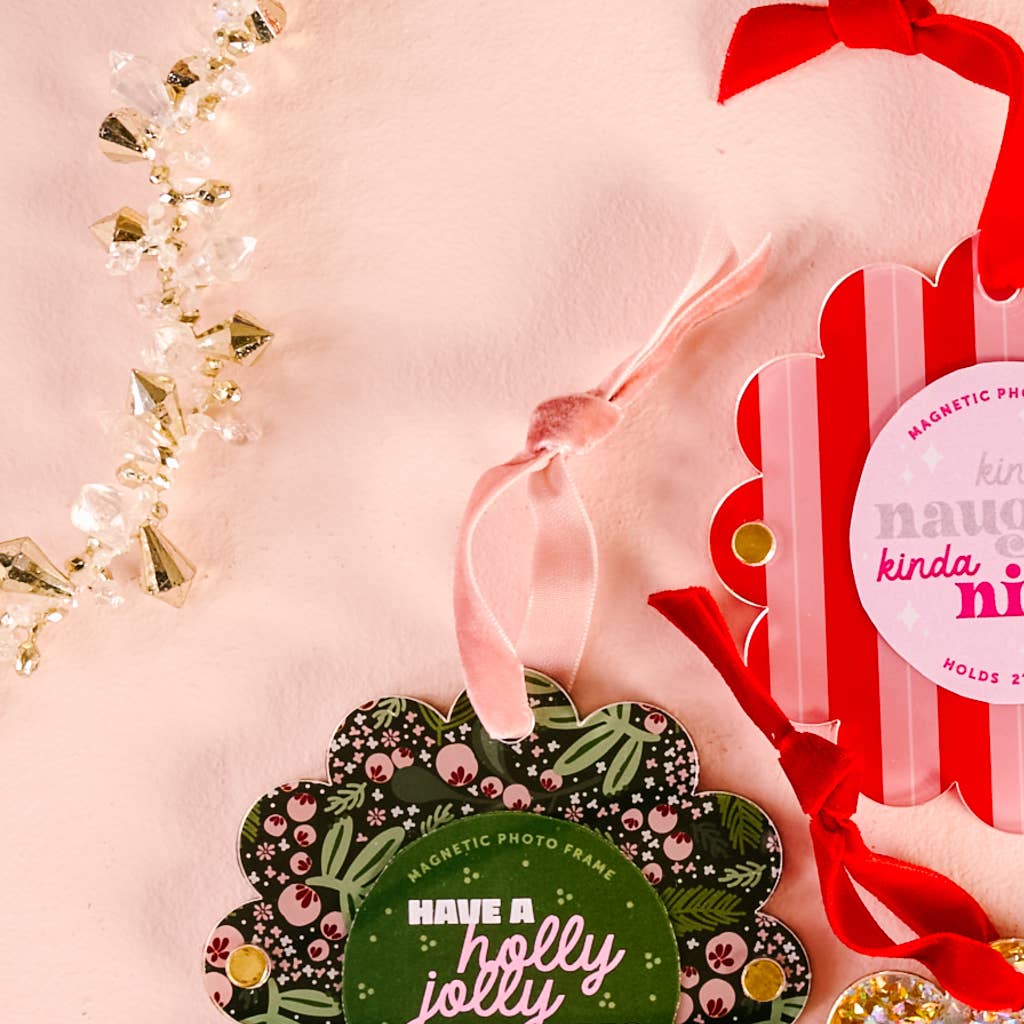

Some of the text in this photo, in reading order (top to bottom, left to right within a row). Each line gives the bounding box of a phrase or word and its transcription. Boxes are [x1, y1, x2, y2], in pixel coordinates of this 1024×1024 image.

[908, 390, 990, 440] MAGNETIC
[877, 544, 980, 582] kinda
[943, 658, 999, 684] HOLDS
[407, 833, 616, 883] MAGNETIC PHOTO FRAME
[408, 898, 535, 925] HAVE A
[457, 915, 626, 996] holly
